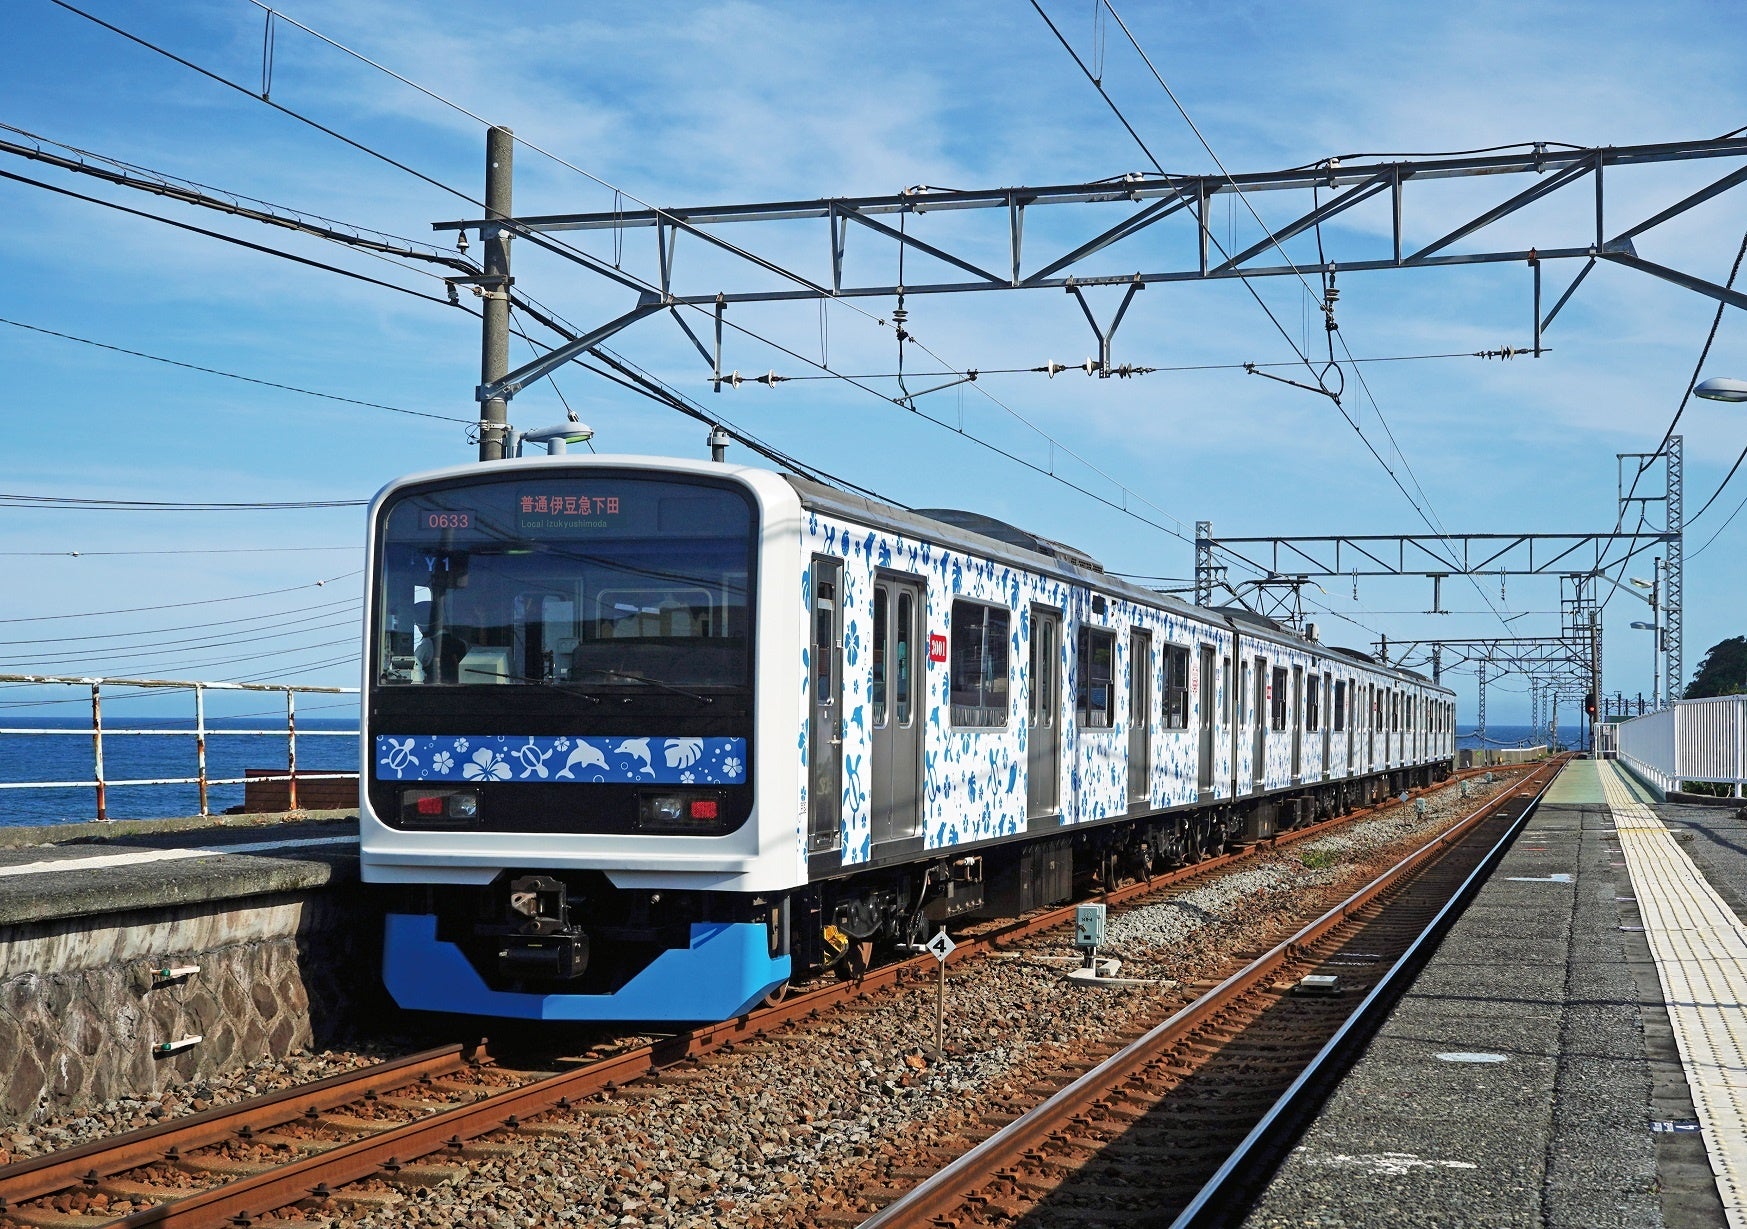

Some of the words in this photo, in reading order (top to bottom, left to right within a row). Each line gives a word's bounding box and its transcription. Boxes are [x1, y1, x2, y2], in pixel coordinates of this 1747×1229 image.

[428, 514, 469, 528] 0633
[521, 519, 544, 528] Local
[932, 938, 947, 953] 4
